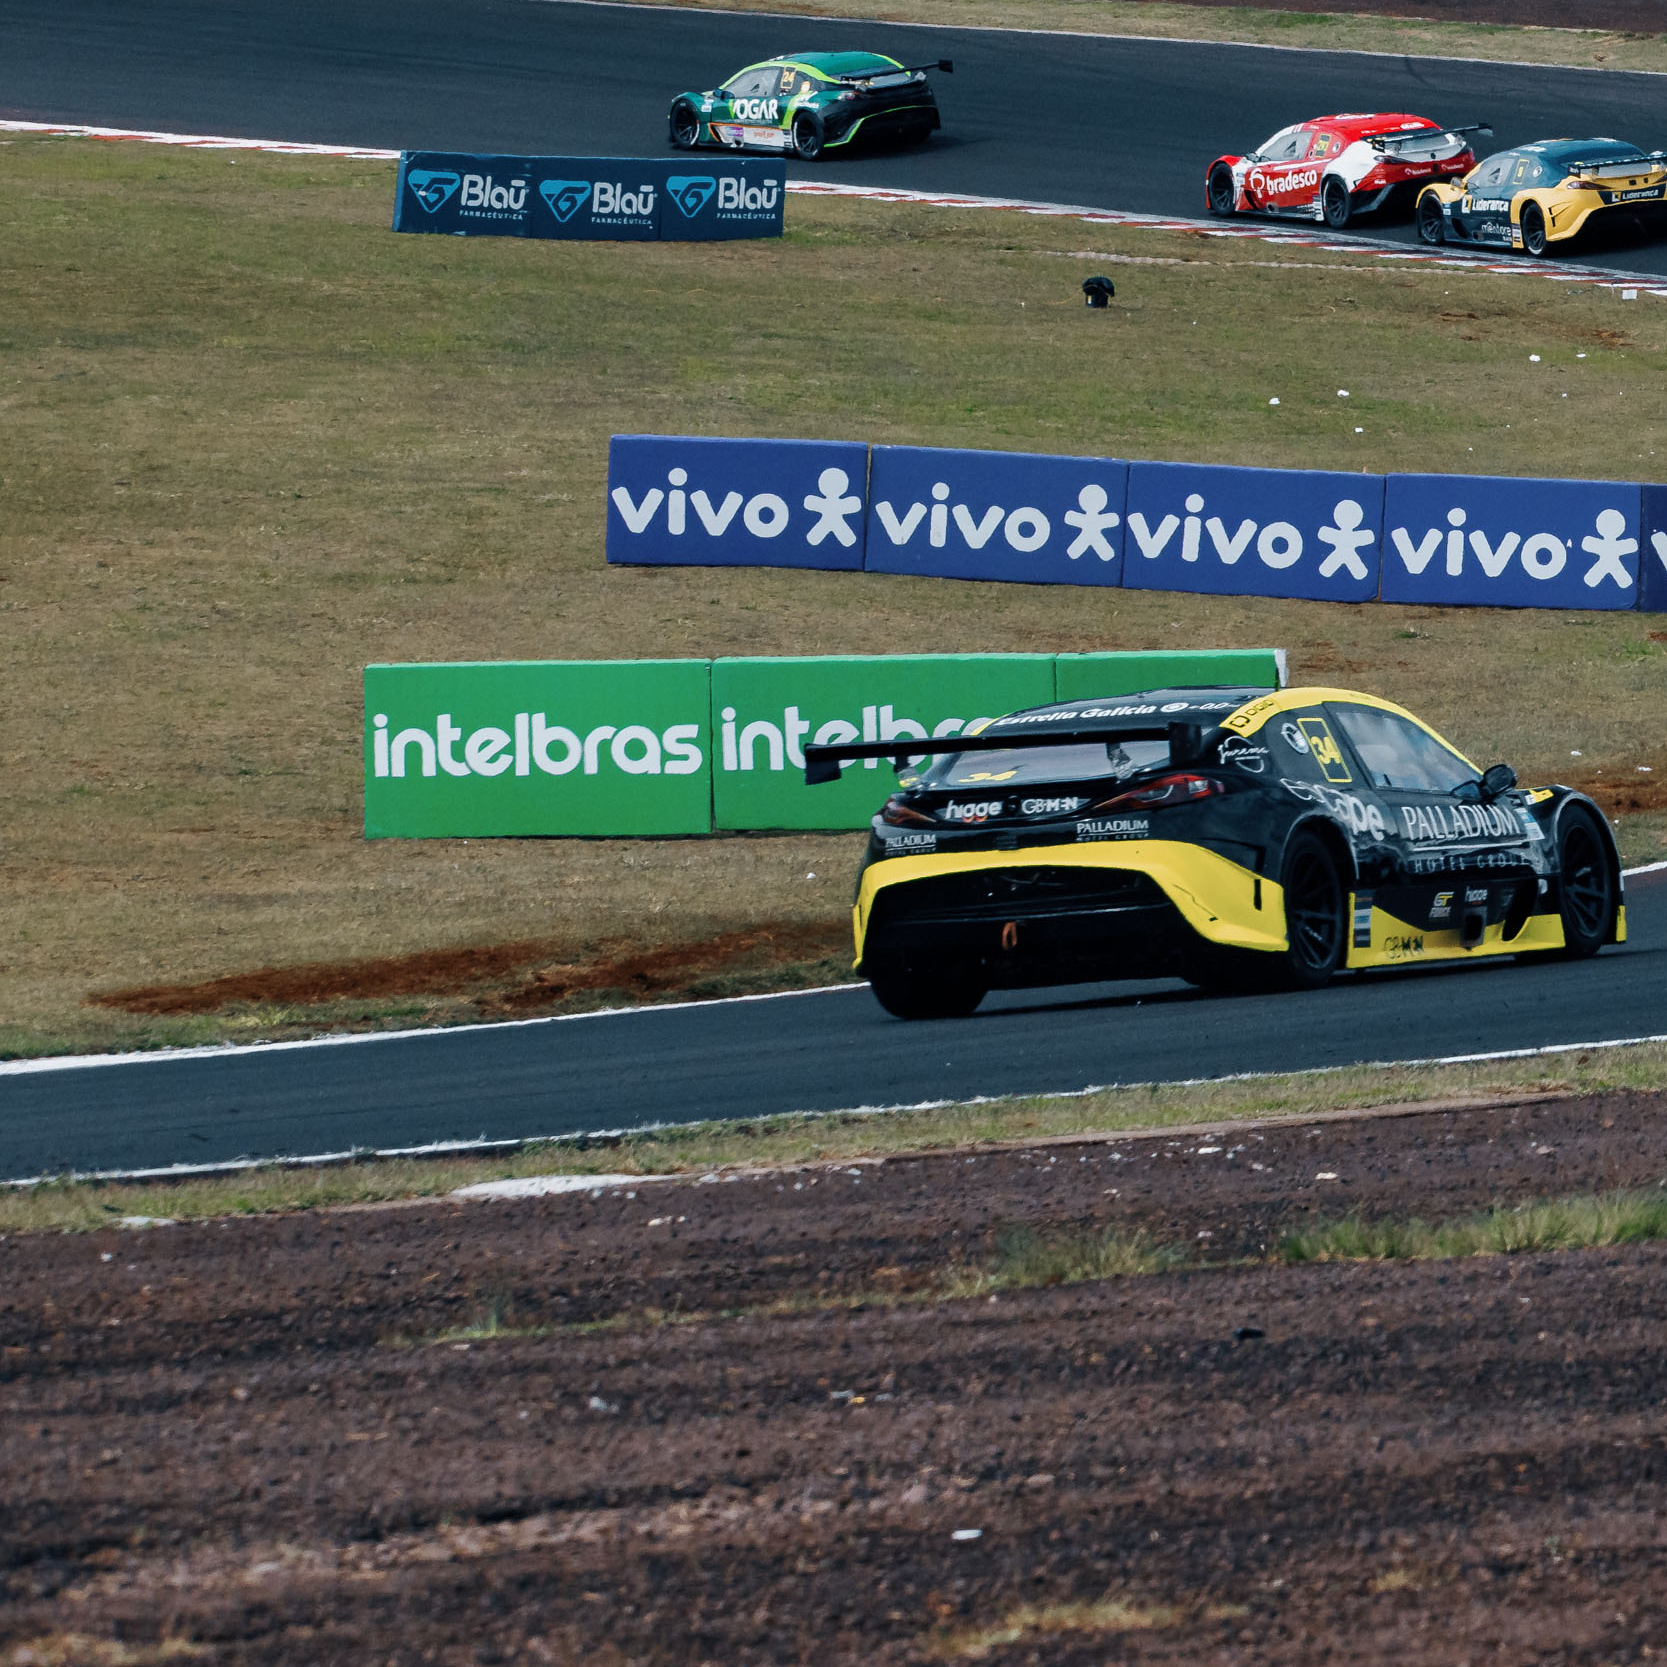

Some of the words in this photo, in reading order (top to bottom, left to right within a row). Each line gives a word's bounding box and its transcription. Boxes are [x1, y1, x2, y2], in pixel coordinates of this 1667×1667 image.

[1266, 168, 1318, 195] bradesco
[611, 467, 790, 538] vivo
[875, 481, 1051, 552] vivo
[1127, 493, 1303, 569] vivo
[1391, 507, 1567, 580] vivo
[994, 708, 1077, 726] Estrella
[1079, 704, 1157, 719] Galicia
[372, 711, 703, 778] intelbras
[1309, 736, 1343, 765] 34
[956, 770, 1018, 783] 34
[1076, 819, 1149, 835] PALLADIUM
[1401, 804, 1521, 842] PALLADIUM
